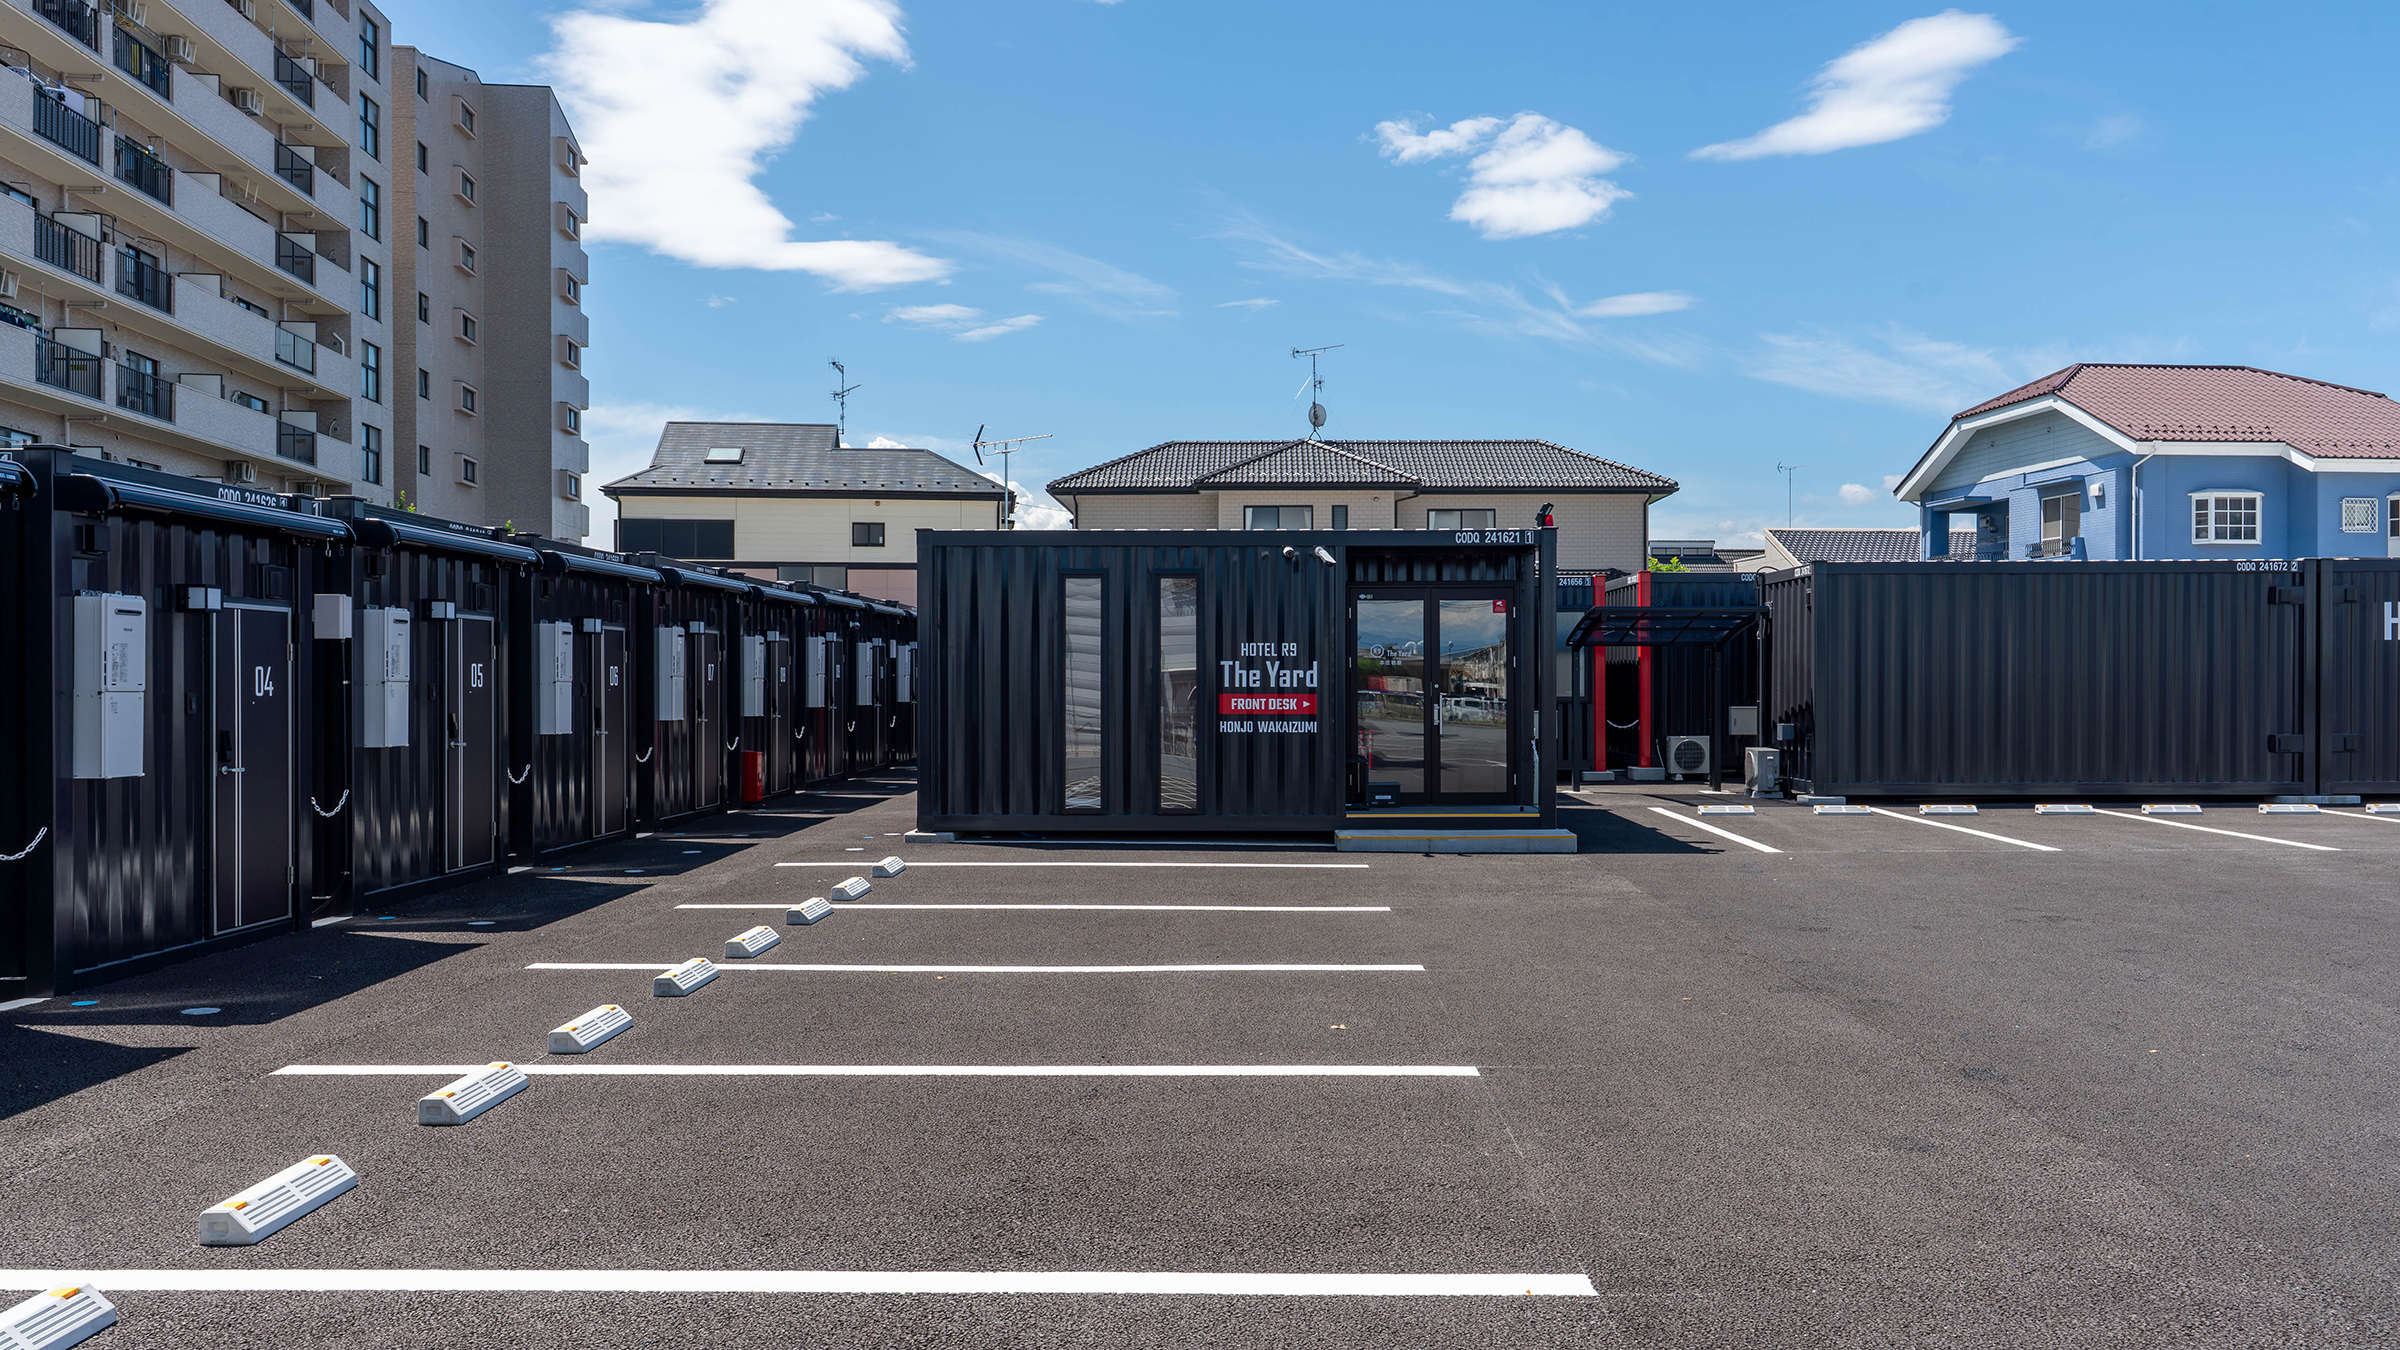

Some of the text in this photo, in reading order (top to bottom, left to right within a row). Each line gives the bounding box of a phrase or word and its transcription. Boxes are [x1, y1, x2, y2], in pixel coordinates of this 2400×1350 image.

[1455, 531, 1480, 544] CODQ
[1485, 531, 1520, 544] 241621
[2236, 561, 2256, 571] CODQ
[2259, 561, 2288, 571] 241672
[1558, 577, 1583, 586] 241656
[1241, 642, 1297, 657] HOTEL R9
[471, 663, 484, 688] 05
[609, 666, 619, 686] 06
[1220, 660, 1318, 688] The Yard
[255, 666, 274, 697] 04
[1231, 698, 1297, 710] FRONT DESK
[1219, 720, 1318, 733] HONJO WAKAIZUMI
